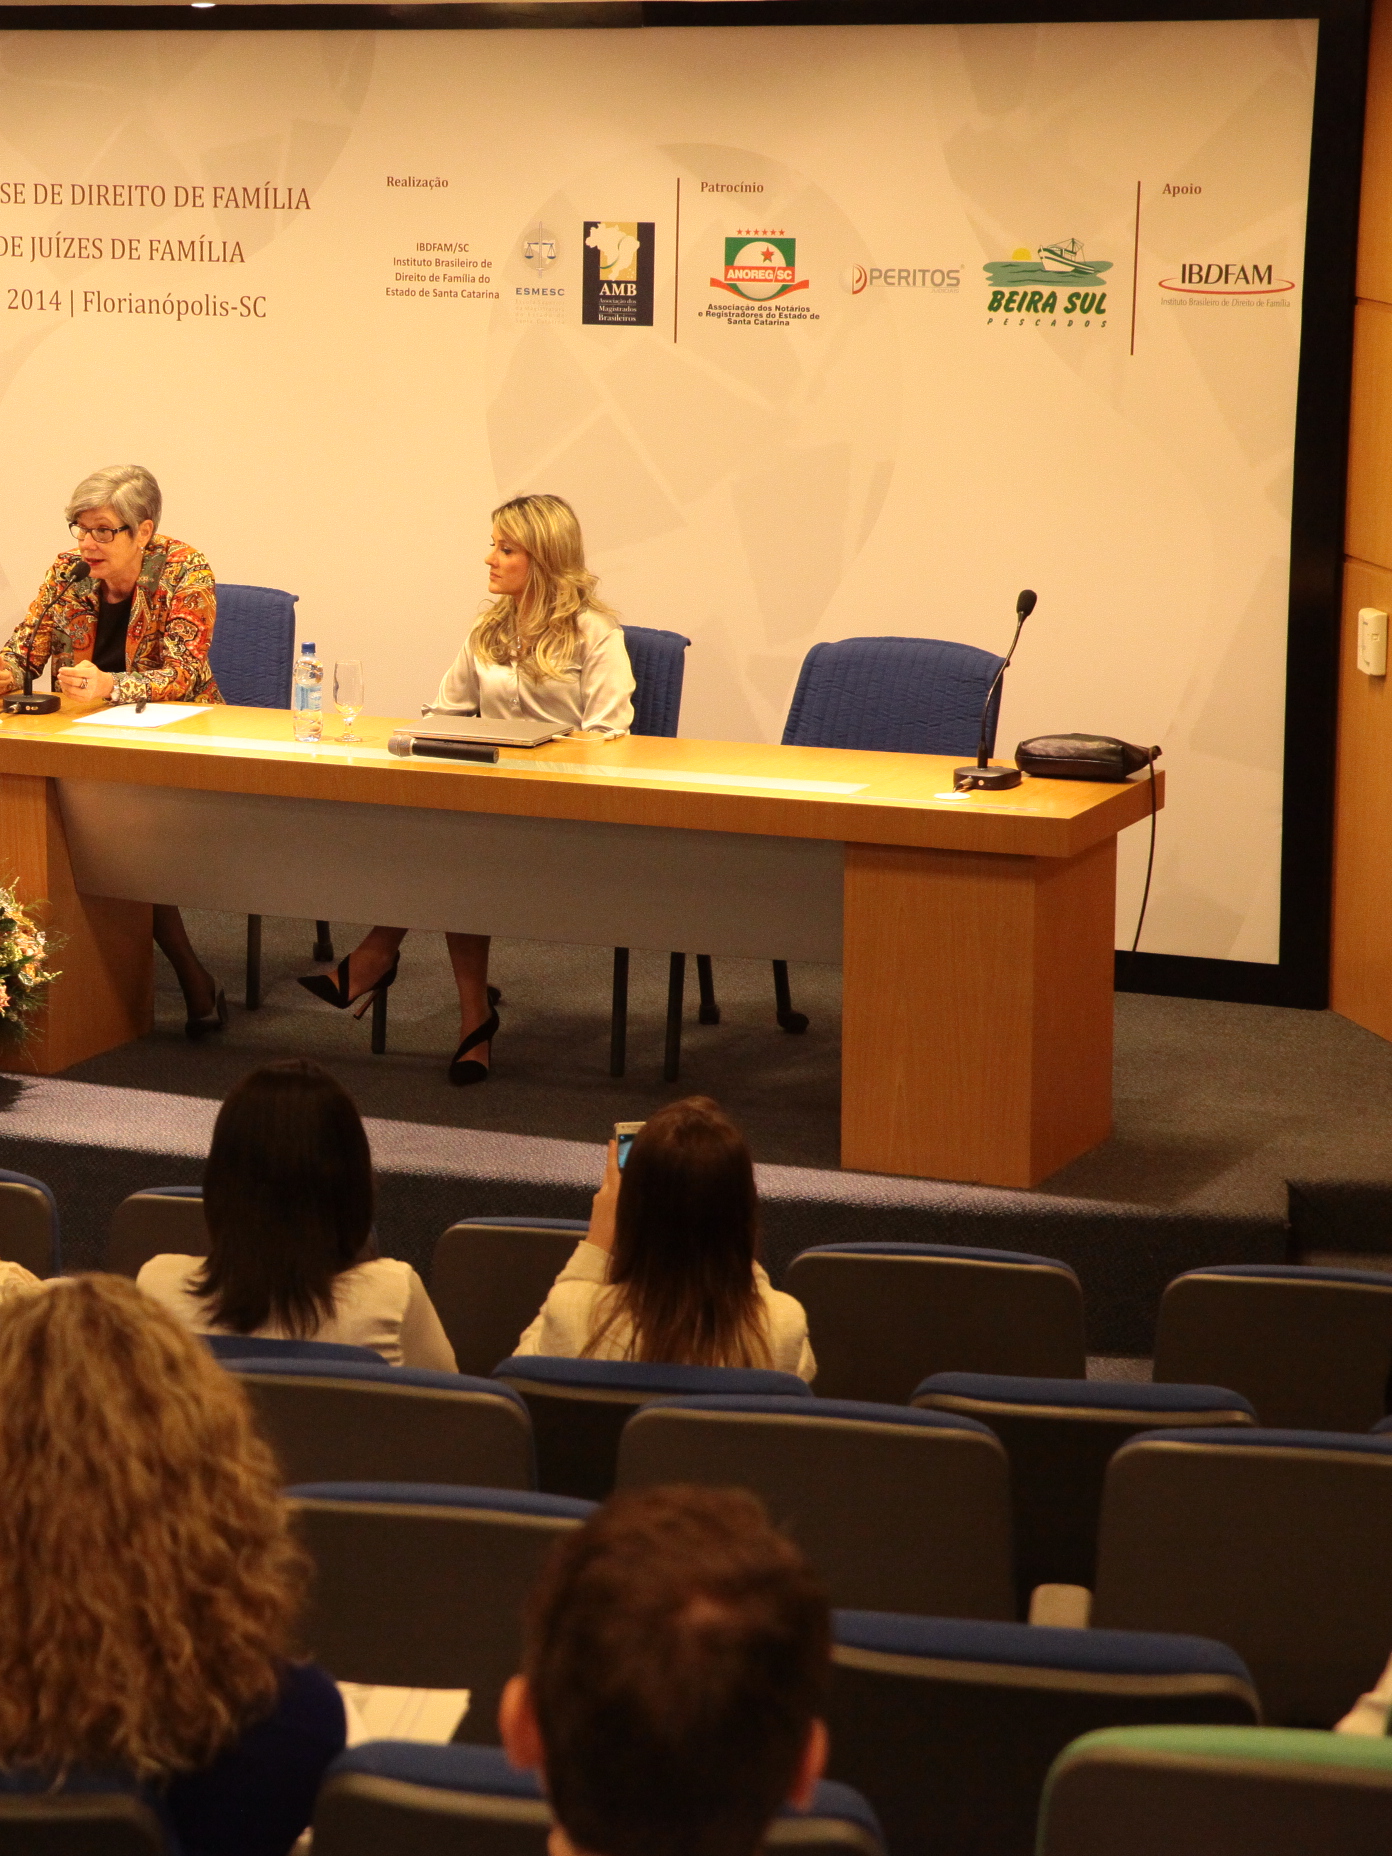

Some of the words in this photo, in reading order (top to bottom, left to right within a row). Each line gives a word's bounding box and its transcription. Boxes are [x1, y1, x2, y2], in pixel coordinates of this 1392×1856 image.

[387, 176, 448, 190] Realização
[700, 181, 764, 194] Patrocínio
[34, 184, 62, 204] DE
[71, 184, 165, 207] DIREITO
[174, 186, 204, 207] DE
[213, 183, 311, 209] FAMÍLIA
[1163, 183, 1201, 197] Apoio
[31, 232, 102, 262] JUÍZES
[111, 239, 140, 260] DE
[149, 235, 245, 262] FAMÍLIA
[417, 243, 469, 253] IBDFAM/SC
[394, 257, 432, 266] Instituto
[435, 258, 478, 267] Brasileiro
[481, 259, 492, 268] de
[396, 272, 426, 281] Direito
[429, 273, 440, 282] de
[443, 274, 475, 283] Família
[479, 274, 490, 283] do
[869, 268, 961, 287] PERITOS
[1182, 264, 1272, 284] IBDFAM
[386, 287, 416, 296] Estado
[419, 288, 430, 297] de
[433, 289, 458, 297] Santa
[461, 289, 499, 299] Catarina
[516, 288, 564, 296] ESMESC
[600, 283, 636, 296] AMB
[8, 289, 61, 311] 2014
[83, 291, 266, 320] Florianópolis-SC
[708, 303, 755, 312] Associação
[775, 304, 810, 312] Notários
[987, 290, 1057, 314] BEIRA
[1064, 291, 1108, 315] SUL
[706, 311, 763, 319] Registradores
[754, 318, 790, 326] Catarina
